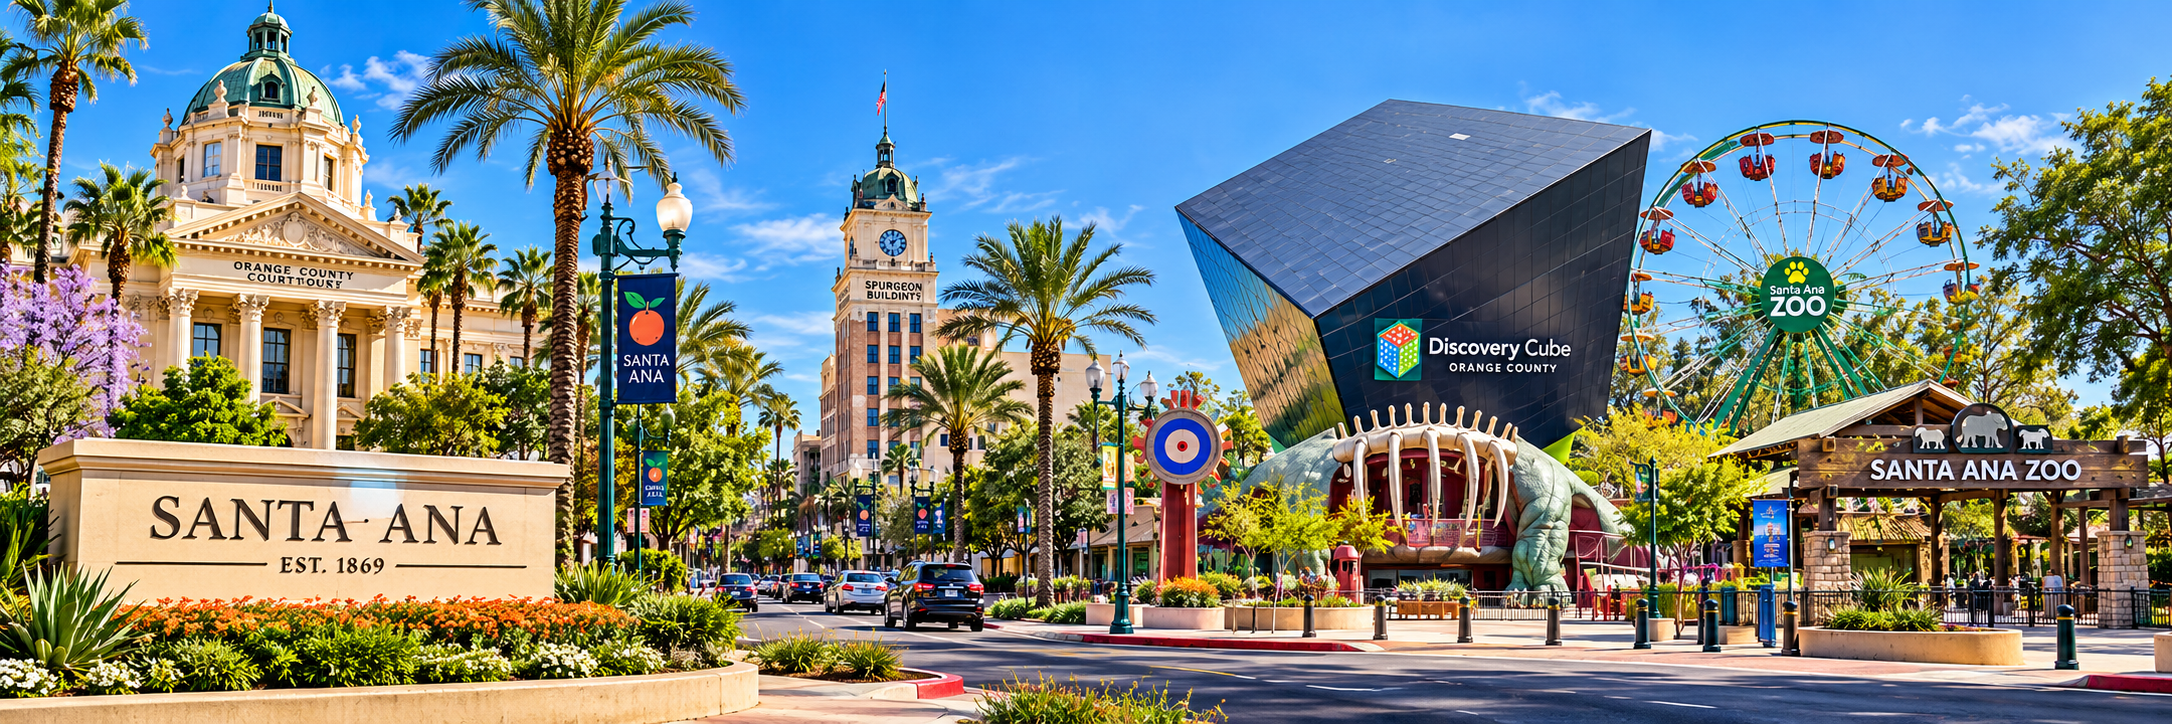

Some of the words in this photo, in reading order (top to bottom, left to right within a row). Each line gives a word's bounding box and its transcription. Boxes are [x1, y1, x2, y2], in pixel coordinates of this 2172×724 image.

[233, 261, 291, 275] ORANGE
[299, 267, 354, 280] COUNTY
[865, 280, 922, 291] SPURGEON
[1769, 285, 1800, 295] Santa
[1803, 284, 1825, 294] Ana
[1770, 295, 1826, 316] ZOO
[1429, 337, 1520, 360] Discovery
[1524, 338, 1571, 356] Cube
[623, 354, 669, 367] SANTA
[1449, 362, 1501, 373] ORANGE
[1506, 363, 1557, 373] COUNTY
[628, 369, 664, 383] ANA
[1870, 458, 1955, 480] SANTA
[1961, 459, 2018, 480] ANA
[2025, 459, 2082, 481] ZOO
[150, 495, 352, 542] SANTA
[378, 502, 502, 545] ANA
[279, 556, 327, 574] EST.
[336, 557, 385, 575] 1869
